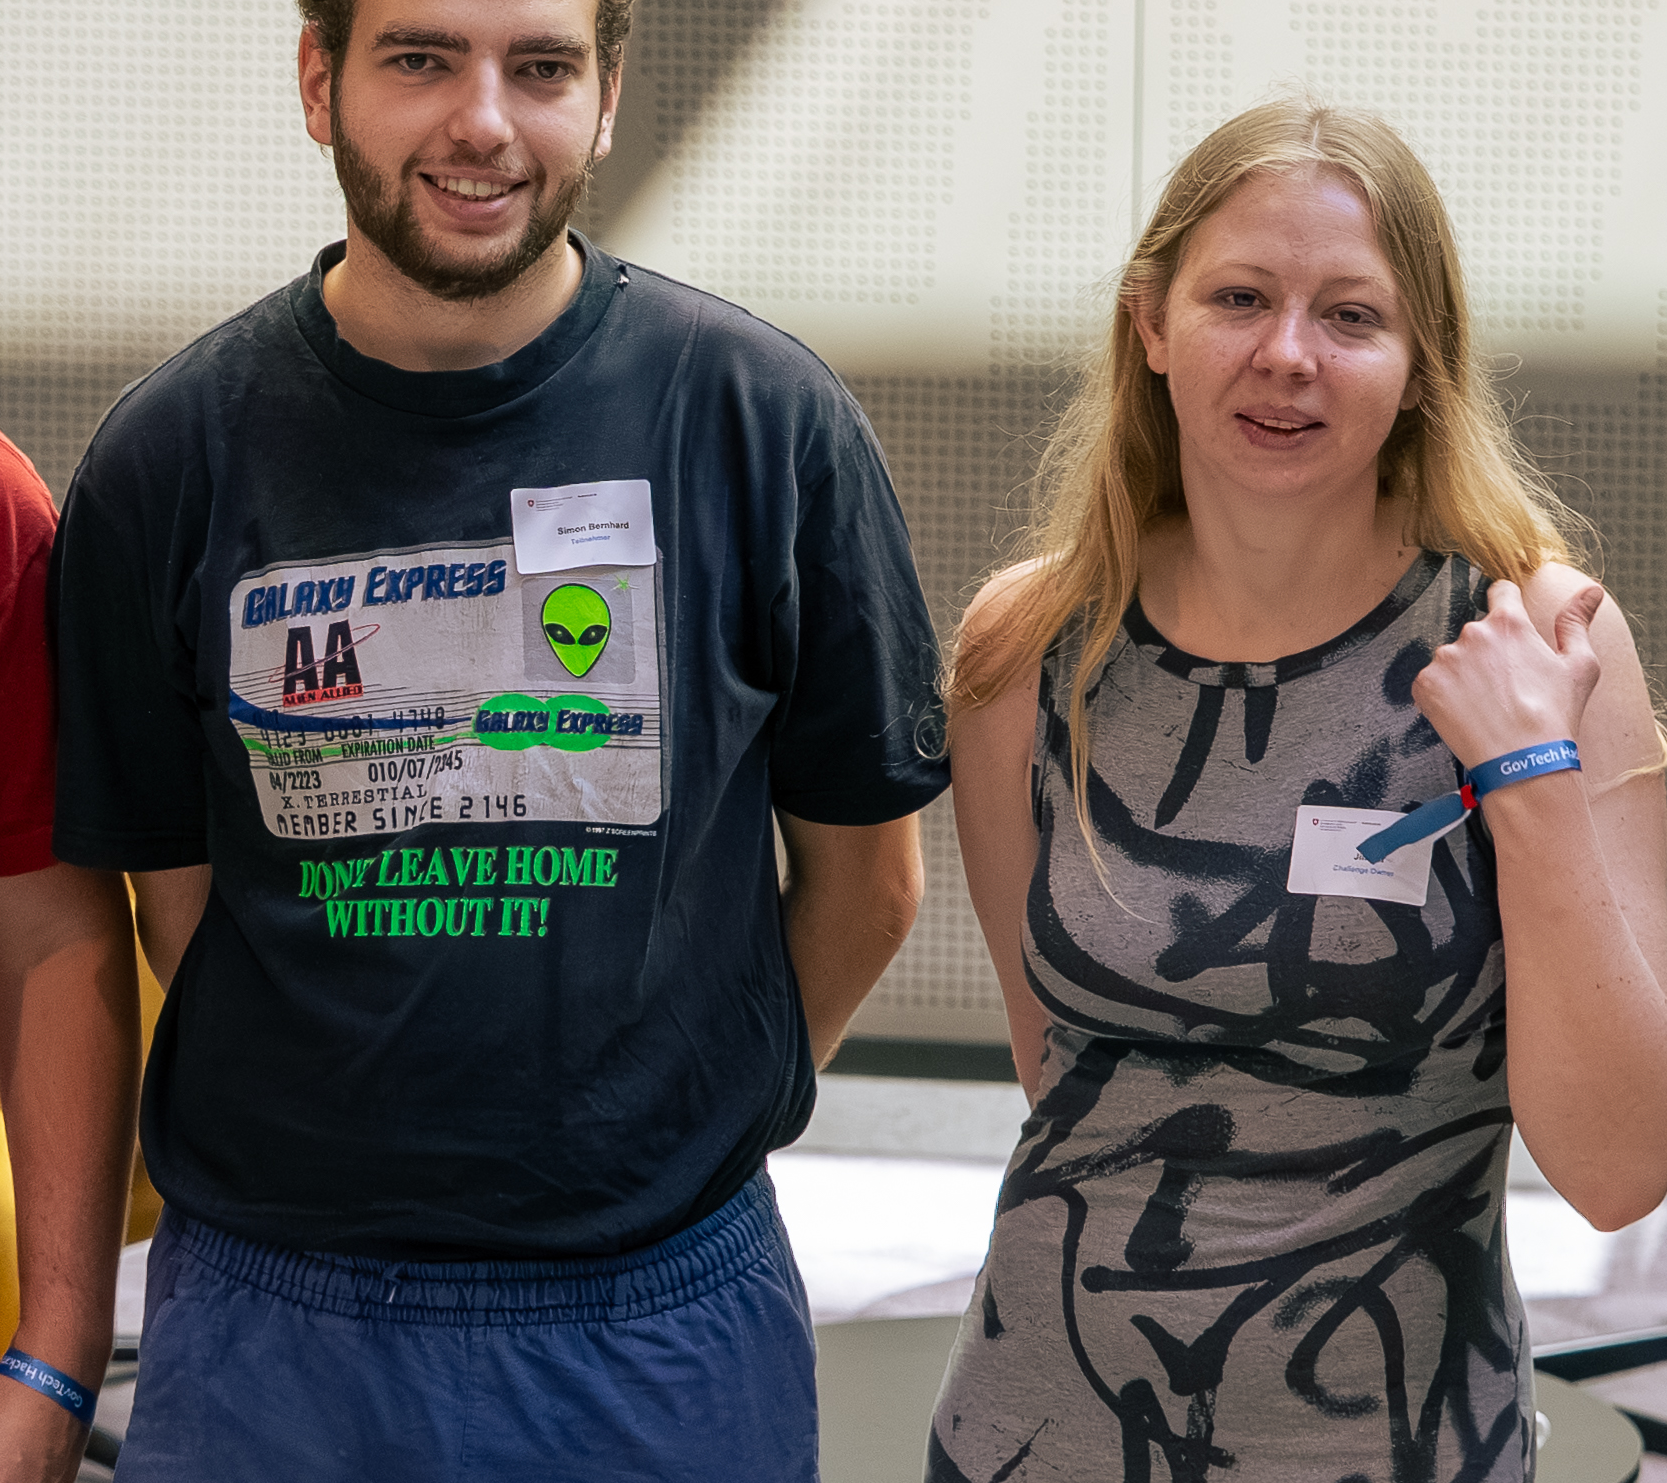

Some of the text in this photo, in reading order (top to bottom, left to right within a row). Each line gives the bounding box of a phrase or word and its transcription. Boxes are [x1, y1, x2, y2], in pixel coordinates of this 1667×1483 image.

[557, 521, 630, 536] Simon Bernhard
[283, 619, 362, 697] AA
[293, 748, 323, 765] FROM
[341, 737, 404, 759] EXPIRATION
[407, 735, 436, 752] DATE
[1500, 749, 1560, 775] GovTech
[276, 794, 527, 837] MEMBER SINCE 2146
[376, 846, 498, 887] LEAVE
[504, 845, 620, 888] HOME
[326, 896, 551, 938] WITHOUT IT!
[38, 1370, 83, 1408] GovTech
